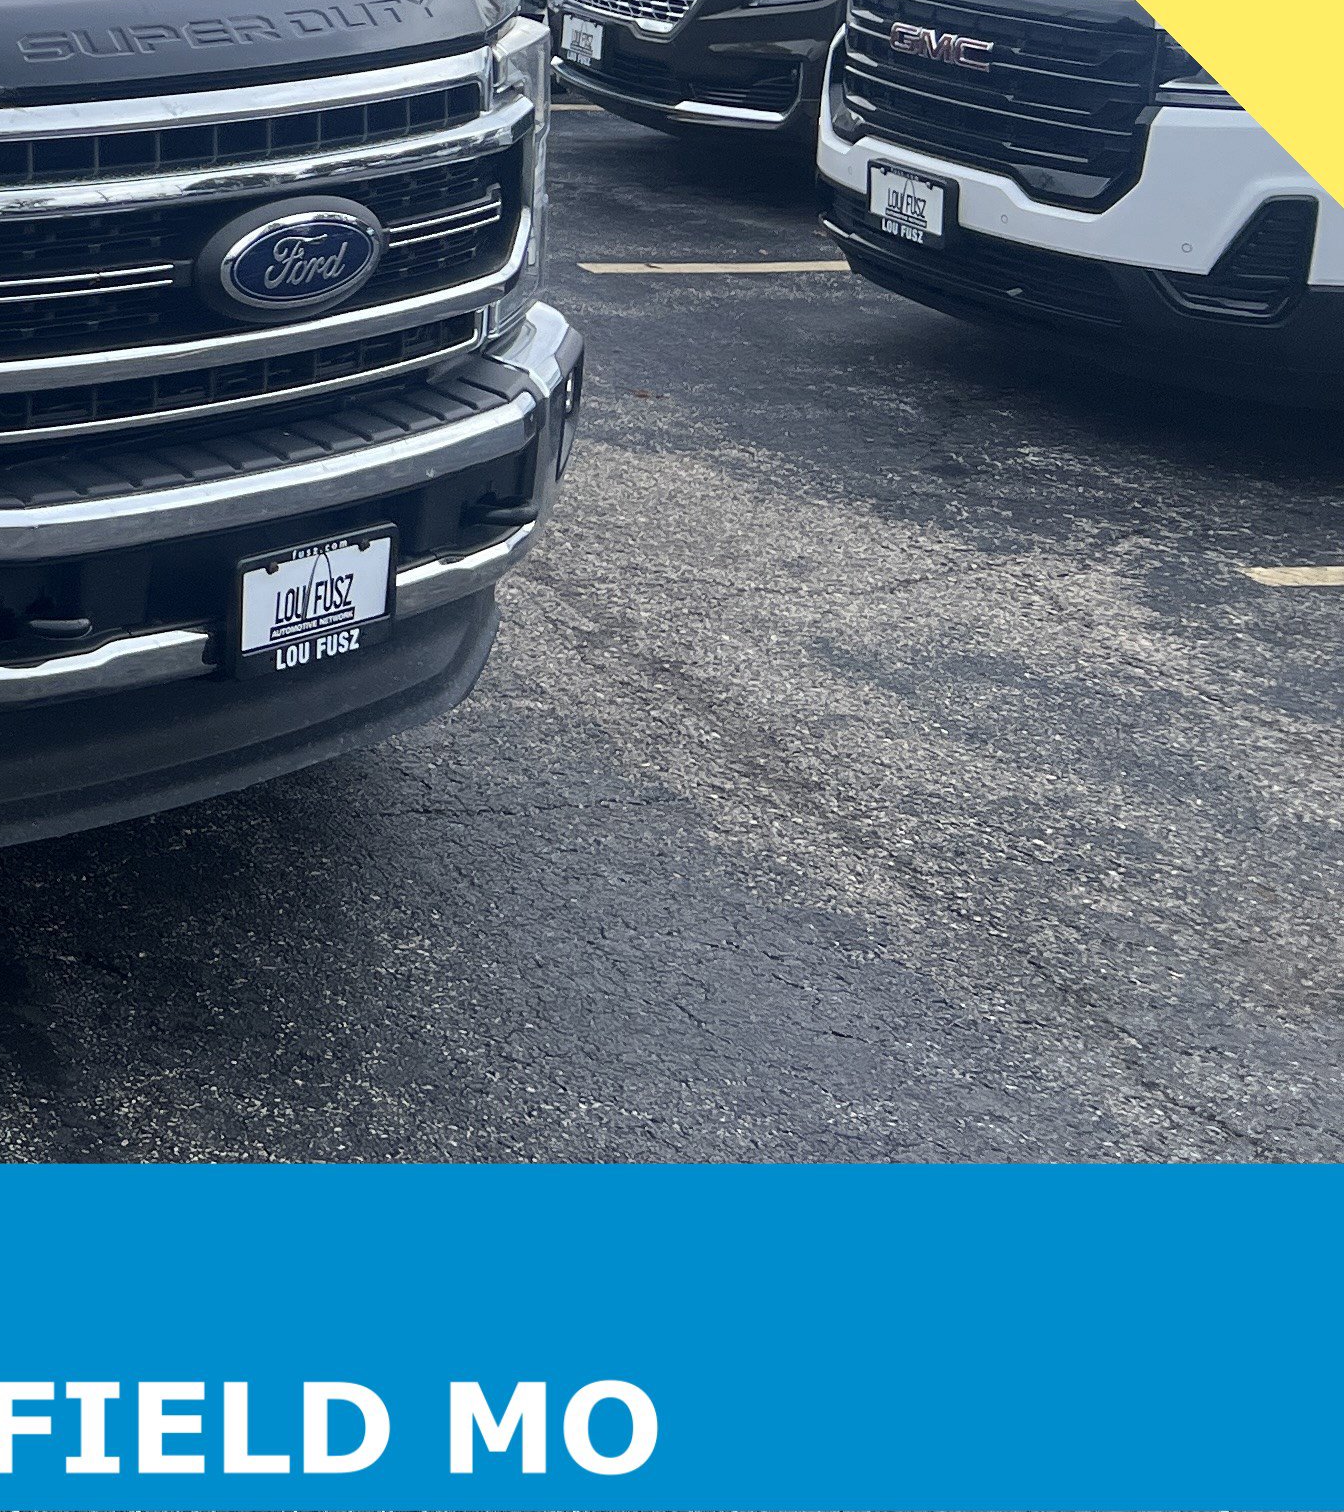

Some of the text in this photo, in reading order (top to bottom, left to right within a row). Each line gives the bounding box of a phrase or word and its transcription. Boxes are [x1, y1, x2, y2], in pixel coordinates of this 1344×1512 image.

[16, 14, 283, 63] SUPER
[890, 21, 994, 73] GMC
[881, 217, 899, 235] LOU
[900, 225, 924, 244] FUSZ
[264, 233, 348, 289] Ford
[291, 539, 348, 561] fusz.com
[275, 573, 354, 624] LOU FUSZ
[271, 610, 355, 638] AUTOMOTIVE NETWORK
[276, 628, 360, 670] LOU FUSZ
